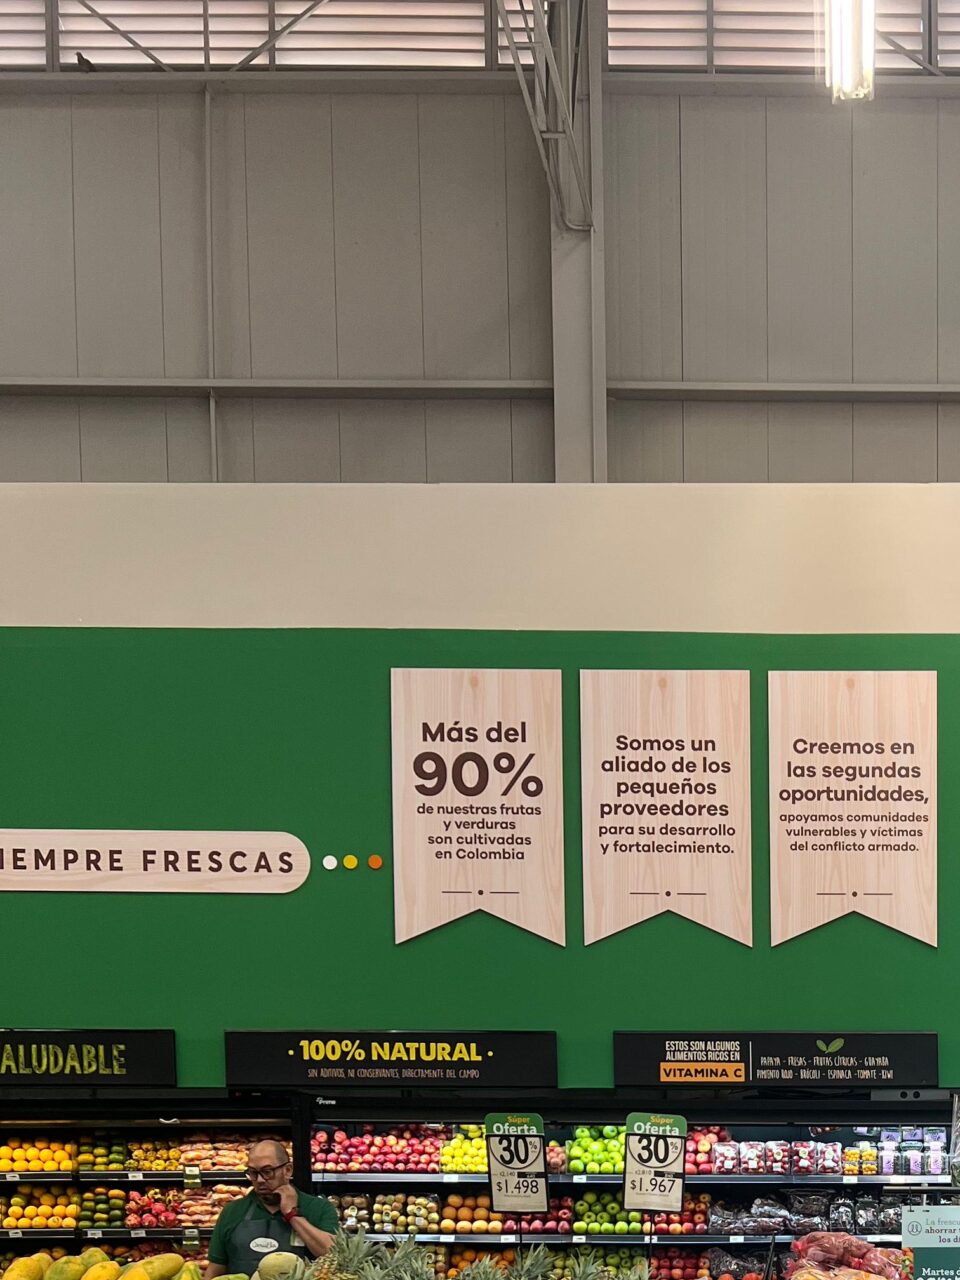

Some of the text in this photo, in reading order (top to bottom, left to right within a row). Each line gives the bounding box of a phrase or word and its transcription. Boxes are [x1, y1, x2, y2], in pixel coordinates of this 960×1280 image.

[422, 721, 526, 742] Más del
[616, 735, 716, 751] Somos un
[793, 739, 915, 754] Creemos en
[601, 756, 731, 773] aliado de los
[787, 761, 921, 781] las segundas
[413, 751, 544, 797] 90%
[616, 778, 717, 797] pequeños
[779, 785, 929, 804] oportunidades,
[416, 803, 542, 815] de nuestras frutas
[600, 800, 729, 818] proveedores
[443, 818, 516, 831] y verduras
[779, 812, 928, 824] apoyamos comunidades
[599, 824, 736, 837] para su desarrollo
[786, 827, 923, 838] vulnerables y víctimas
[428, 834, 532, 845] son cultivadas
[601, 841, 734, 854] y fortalecimiento.
[790, 841, 919, 852] del conflicto armado.
[435, 848, 525, 860] en Colombia
[142, 850, 294, 873] FRESCAS
[299, 1040, 482, 1061] 100% NATURAL
[666, 1041, 740, 1050] ESTOS SON ALGUNOS
[0, 1044, 127, 1076] ALUDABLE
[666, 1051, 740, 1060] ALIMENTOS RICOS EN
[761, 1056, 780, 1066] PAPAYA
[788, 1056, 807, 1066] FRESAS
[813, 1056, 833, 1066] FRUTAS
[308, 1069, 318, 1078] SIN
[347, 1069, 354, 1078] NI
[446, 1069, 456, 1078] DEL
[459, 1069, 480, 1079] CAMPO
[663, 1068, 742, 1078] VITAMINA C
[493, 1123, 537, 1135] Oferta
[633, 1122, 679, 1135] Oferta
[496, 1179, 539, 1194] $1.498
[630, 1178, 676, 1193] $1.967
[922, 1268, 954, 1276] Martes
